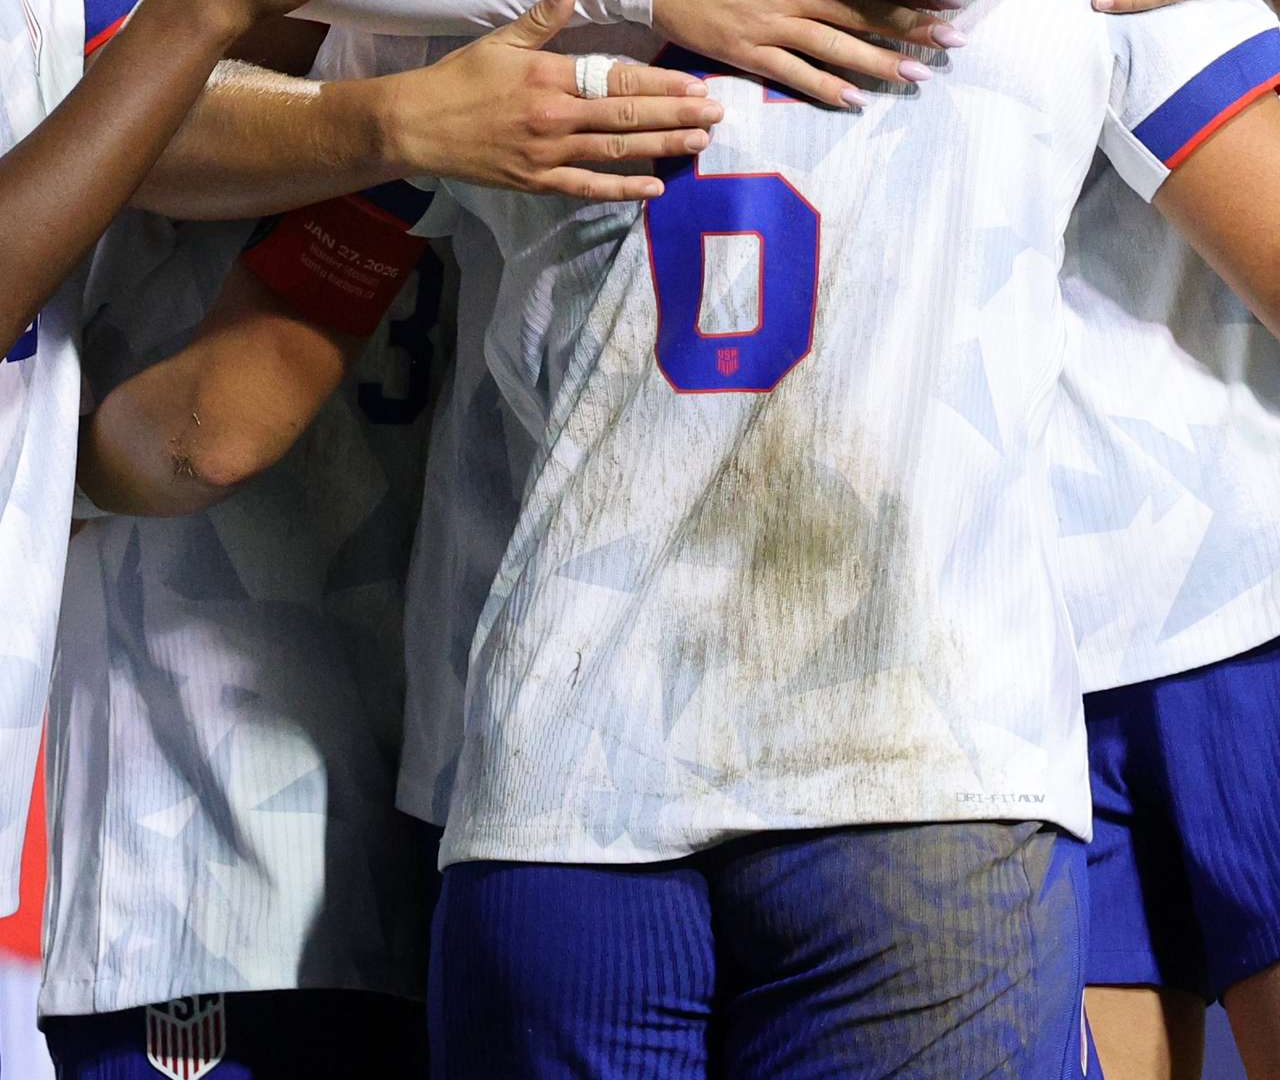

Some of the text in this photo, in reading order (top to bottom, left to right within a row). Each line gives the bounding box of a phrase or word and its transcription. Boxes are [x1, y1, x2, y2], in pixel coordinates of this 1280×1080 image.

[304, 221, 336, 248] JAN
[644, 42, 821, 394] 6
[358, 244, 444, 425] 3
